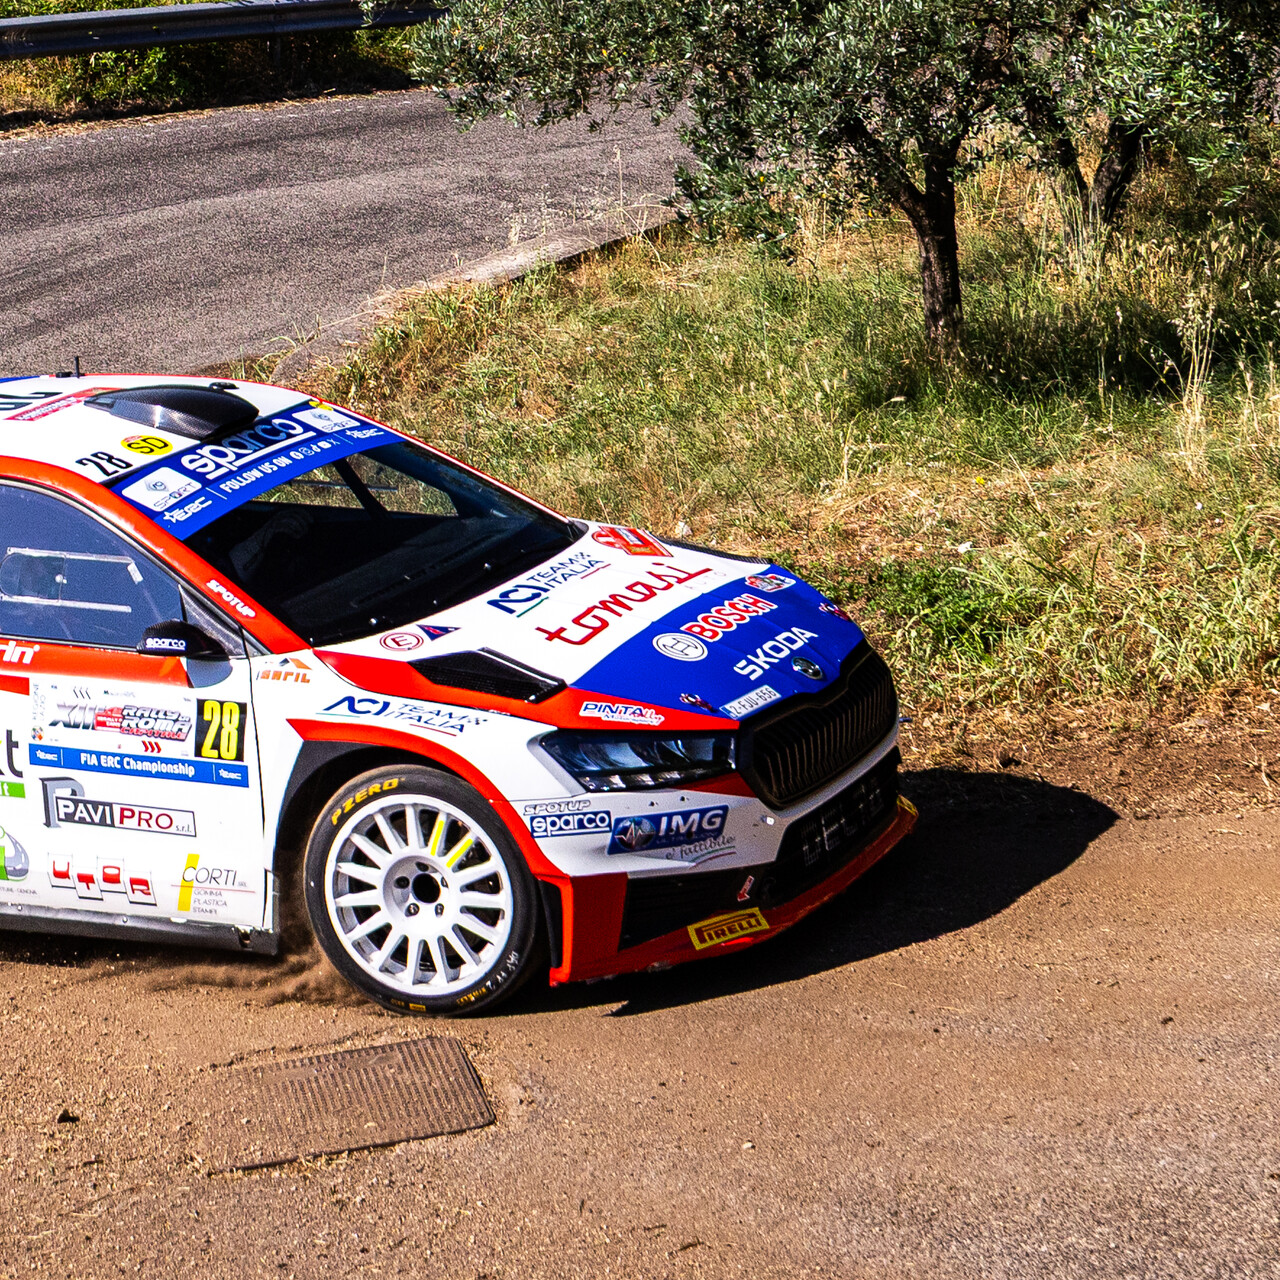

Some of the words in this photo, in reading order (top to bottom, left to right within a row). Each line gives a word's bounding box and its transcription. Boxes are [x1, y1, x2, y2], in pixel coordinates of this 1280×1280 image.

[127, 437, 169, 454] SD
[181, 418, 305, 473] sparco
[75, 451, 133, 477] 28
[219, 468, 263, 493] FOLLOW
[260, 463, 278, 475] US
[273, 456, 292, 468] ON
[527, 557, 576, 582] TEAM
[543, 559, 605, 589] ITALIA
[206, 579, 256, 618] SPOTUP
[535, 562, 714, 646] tomasi
[680, 593, 778, 642] BOSCH
[146, 638, 186, 650] sparco
[122, 705, 181, 720] RALLY
[323, 695, 391, 716] ACI
[398, 703, 466, 721] TEAM
[121, 716, 192, 733] ROMA
[201, 700, 239, 760] 28
[384, 711, 465, 733] ITALIA
[80, 753, 98, 767] FIA
[101, 755, 120, 769] ERC
[123, 757, 195, 777] Championship
[523, 799, 591, 815] SPOTUP
[532, 813, 610, 836] sparco
[659, 809, 724, 836] IMG
[182, 866, 237, 886] CORTI
[693, 912, 762, 945] PIRELLI
